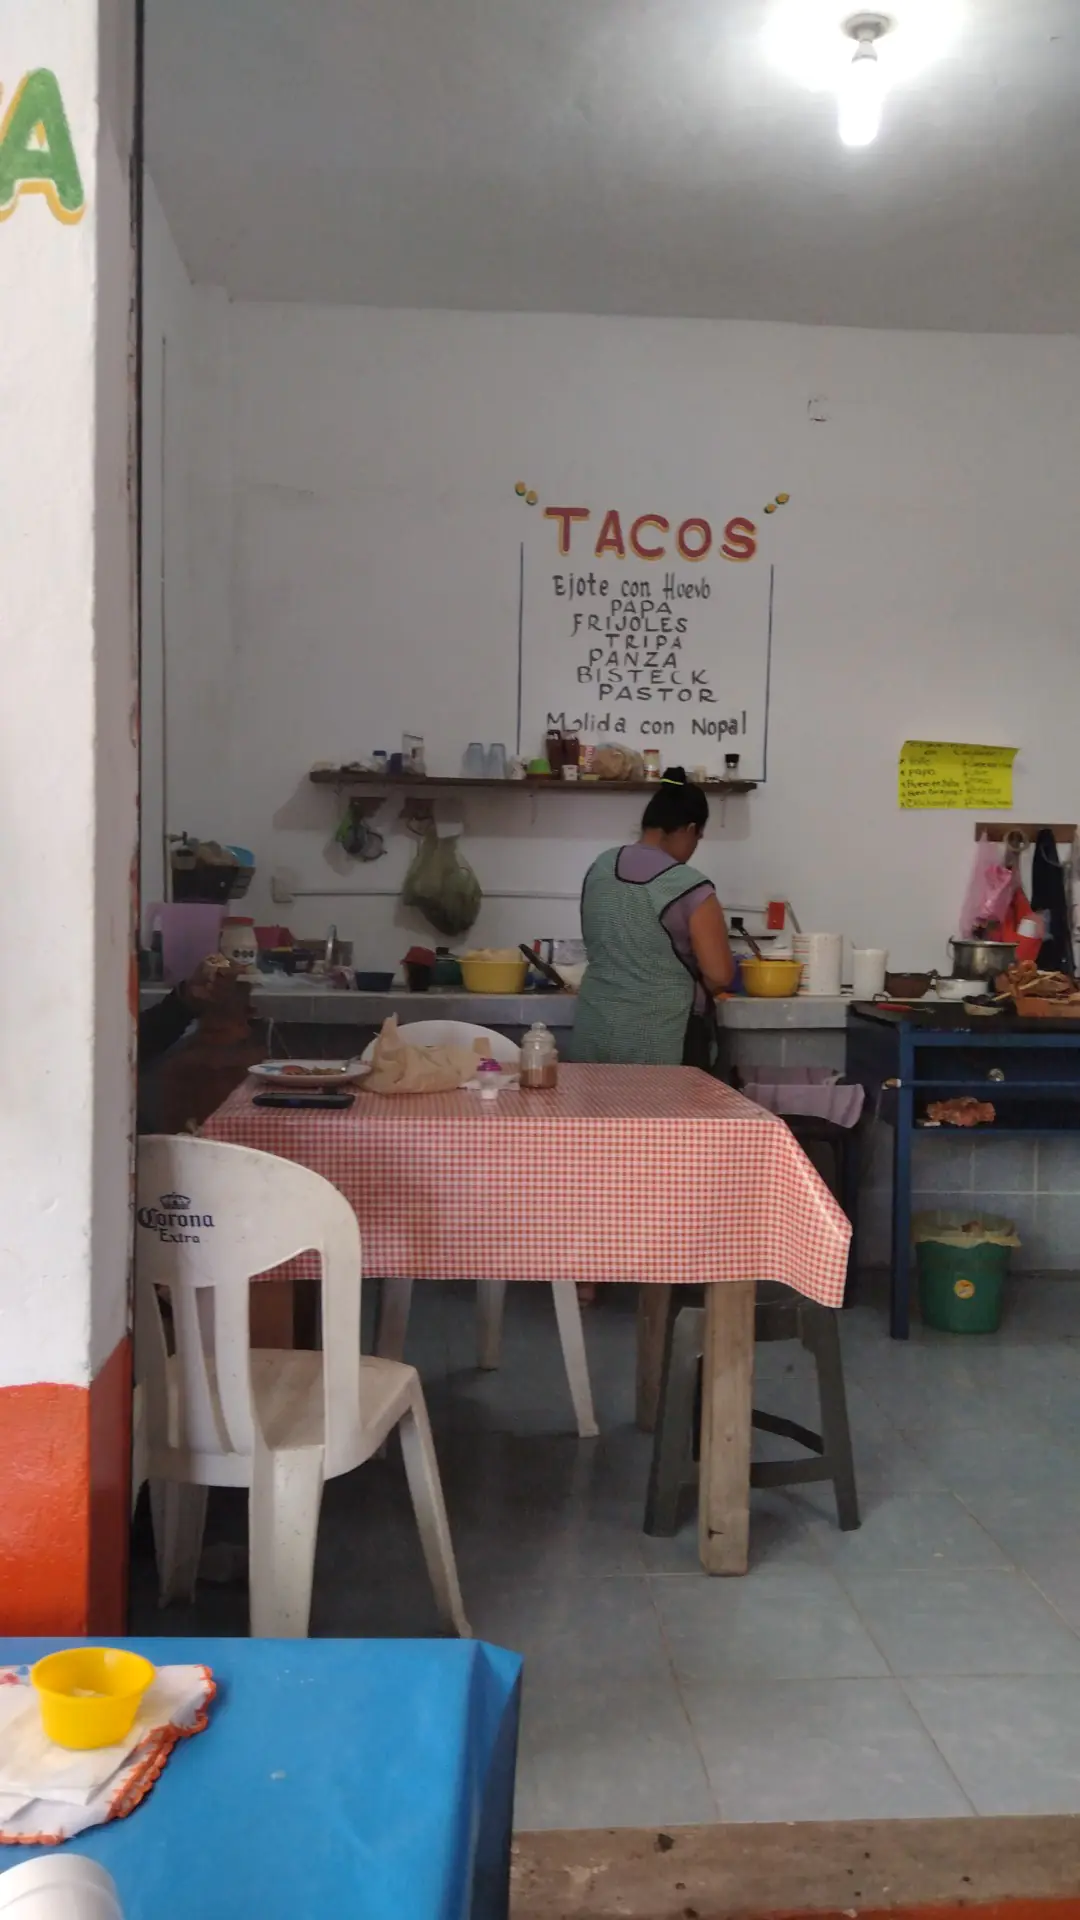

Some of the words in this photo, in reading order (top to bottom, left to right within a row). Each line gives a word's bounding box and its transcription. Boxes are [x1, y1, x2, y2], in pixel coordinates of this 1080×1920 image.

[0, 67, 85, 226] A
[543, 506, 758, 562] TACOS
[552, 572, 609, 600] Ejote
[620, 579, 651, 598] con
[611, 599, 673, 619] PAPA
[570, 613, 689, 637] FRIJOLES
[605, 633, 683, 650] TRIPA
[588, 648, 678, 668] PANZA
[576, 665, 710, 684] BISTECK
[598, 683, 719, 703] PASTOR
[546, 712, 627, 733] Molida
[640, 719, 675, 735] con
[691, 710, 747, 742] Nopal
[137, 1206, 216, 1229] Corona
[153, 1228, 201, 1243] Extra
